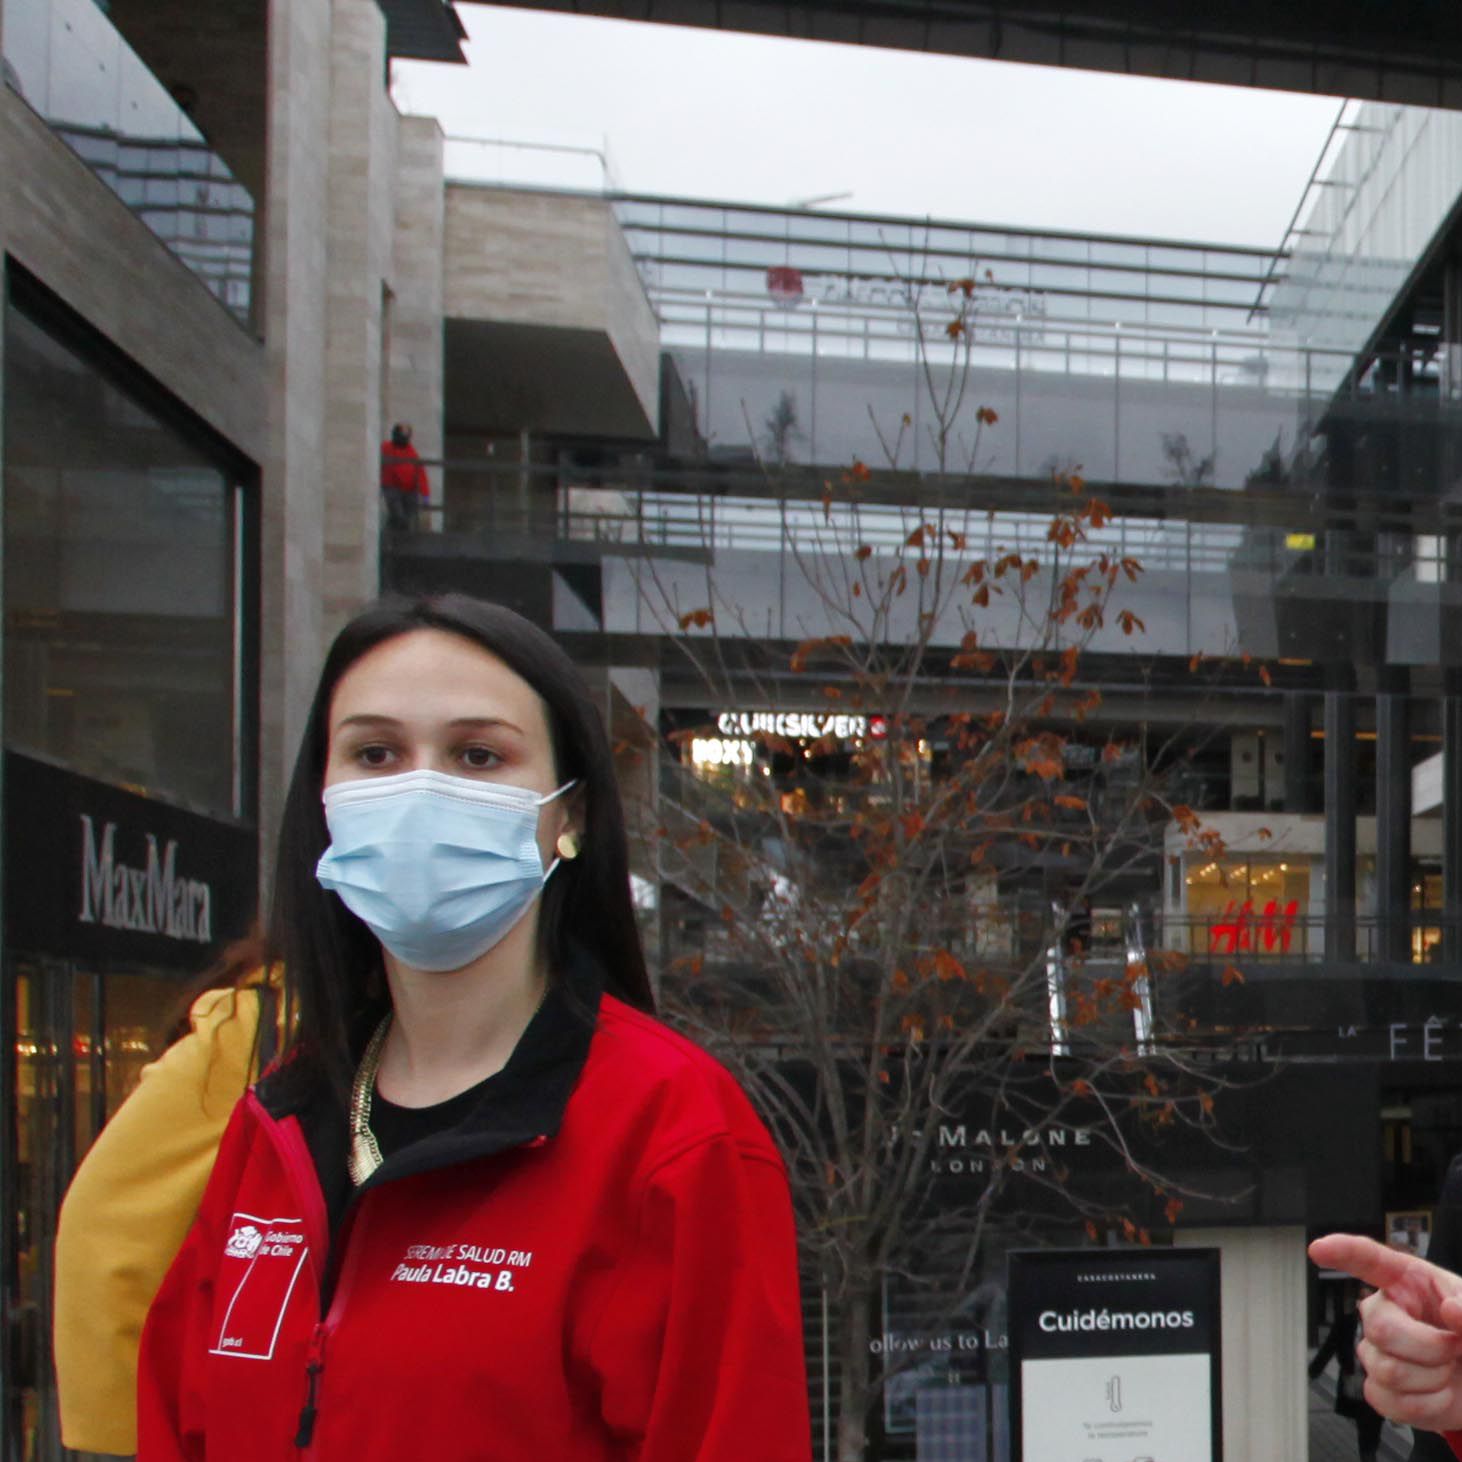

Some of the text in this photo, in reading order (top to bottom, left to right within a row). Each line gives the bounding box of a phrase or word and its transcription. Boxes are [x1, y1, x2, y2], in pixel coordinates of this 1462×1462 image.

[78, 813, 212, 943] MaxMara
[939, 1125, 1092, 1147] MALONE
[931, 1159, 1046, 1173] LONON
[456, 1244, 506, 1265] SALUD
[507, 1250, 532, 1267] RM
[390, 1263, 515, 1293] Paula Labra B.
[1038, 1309, 1195, 1333] Cuidémonos
